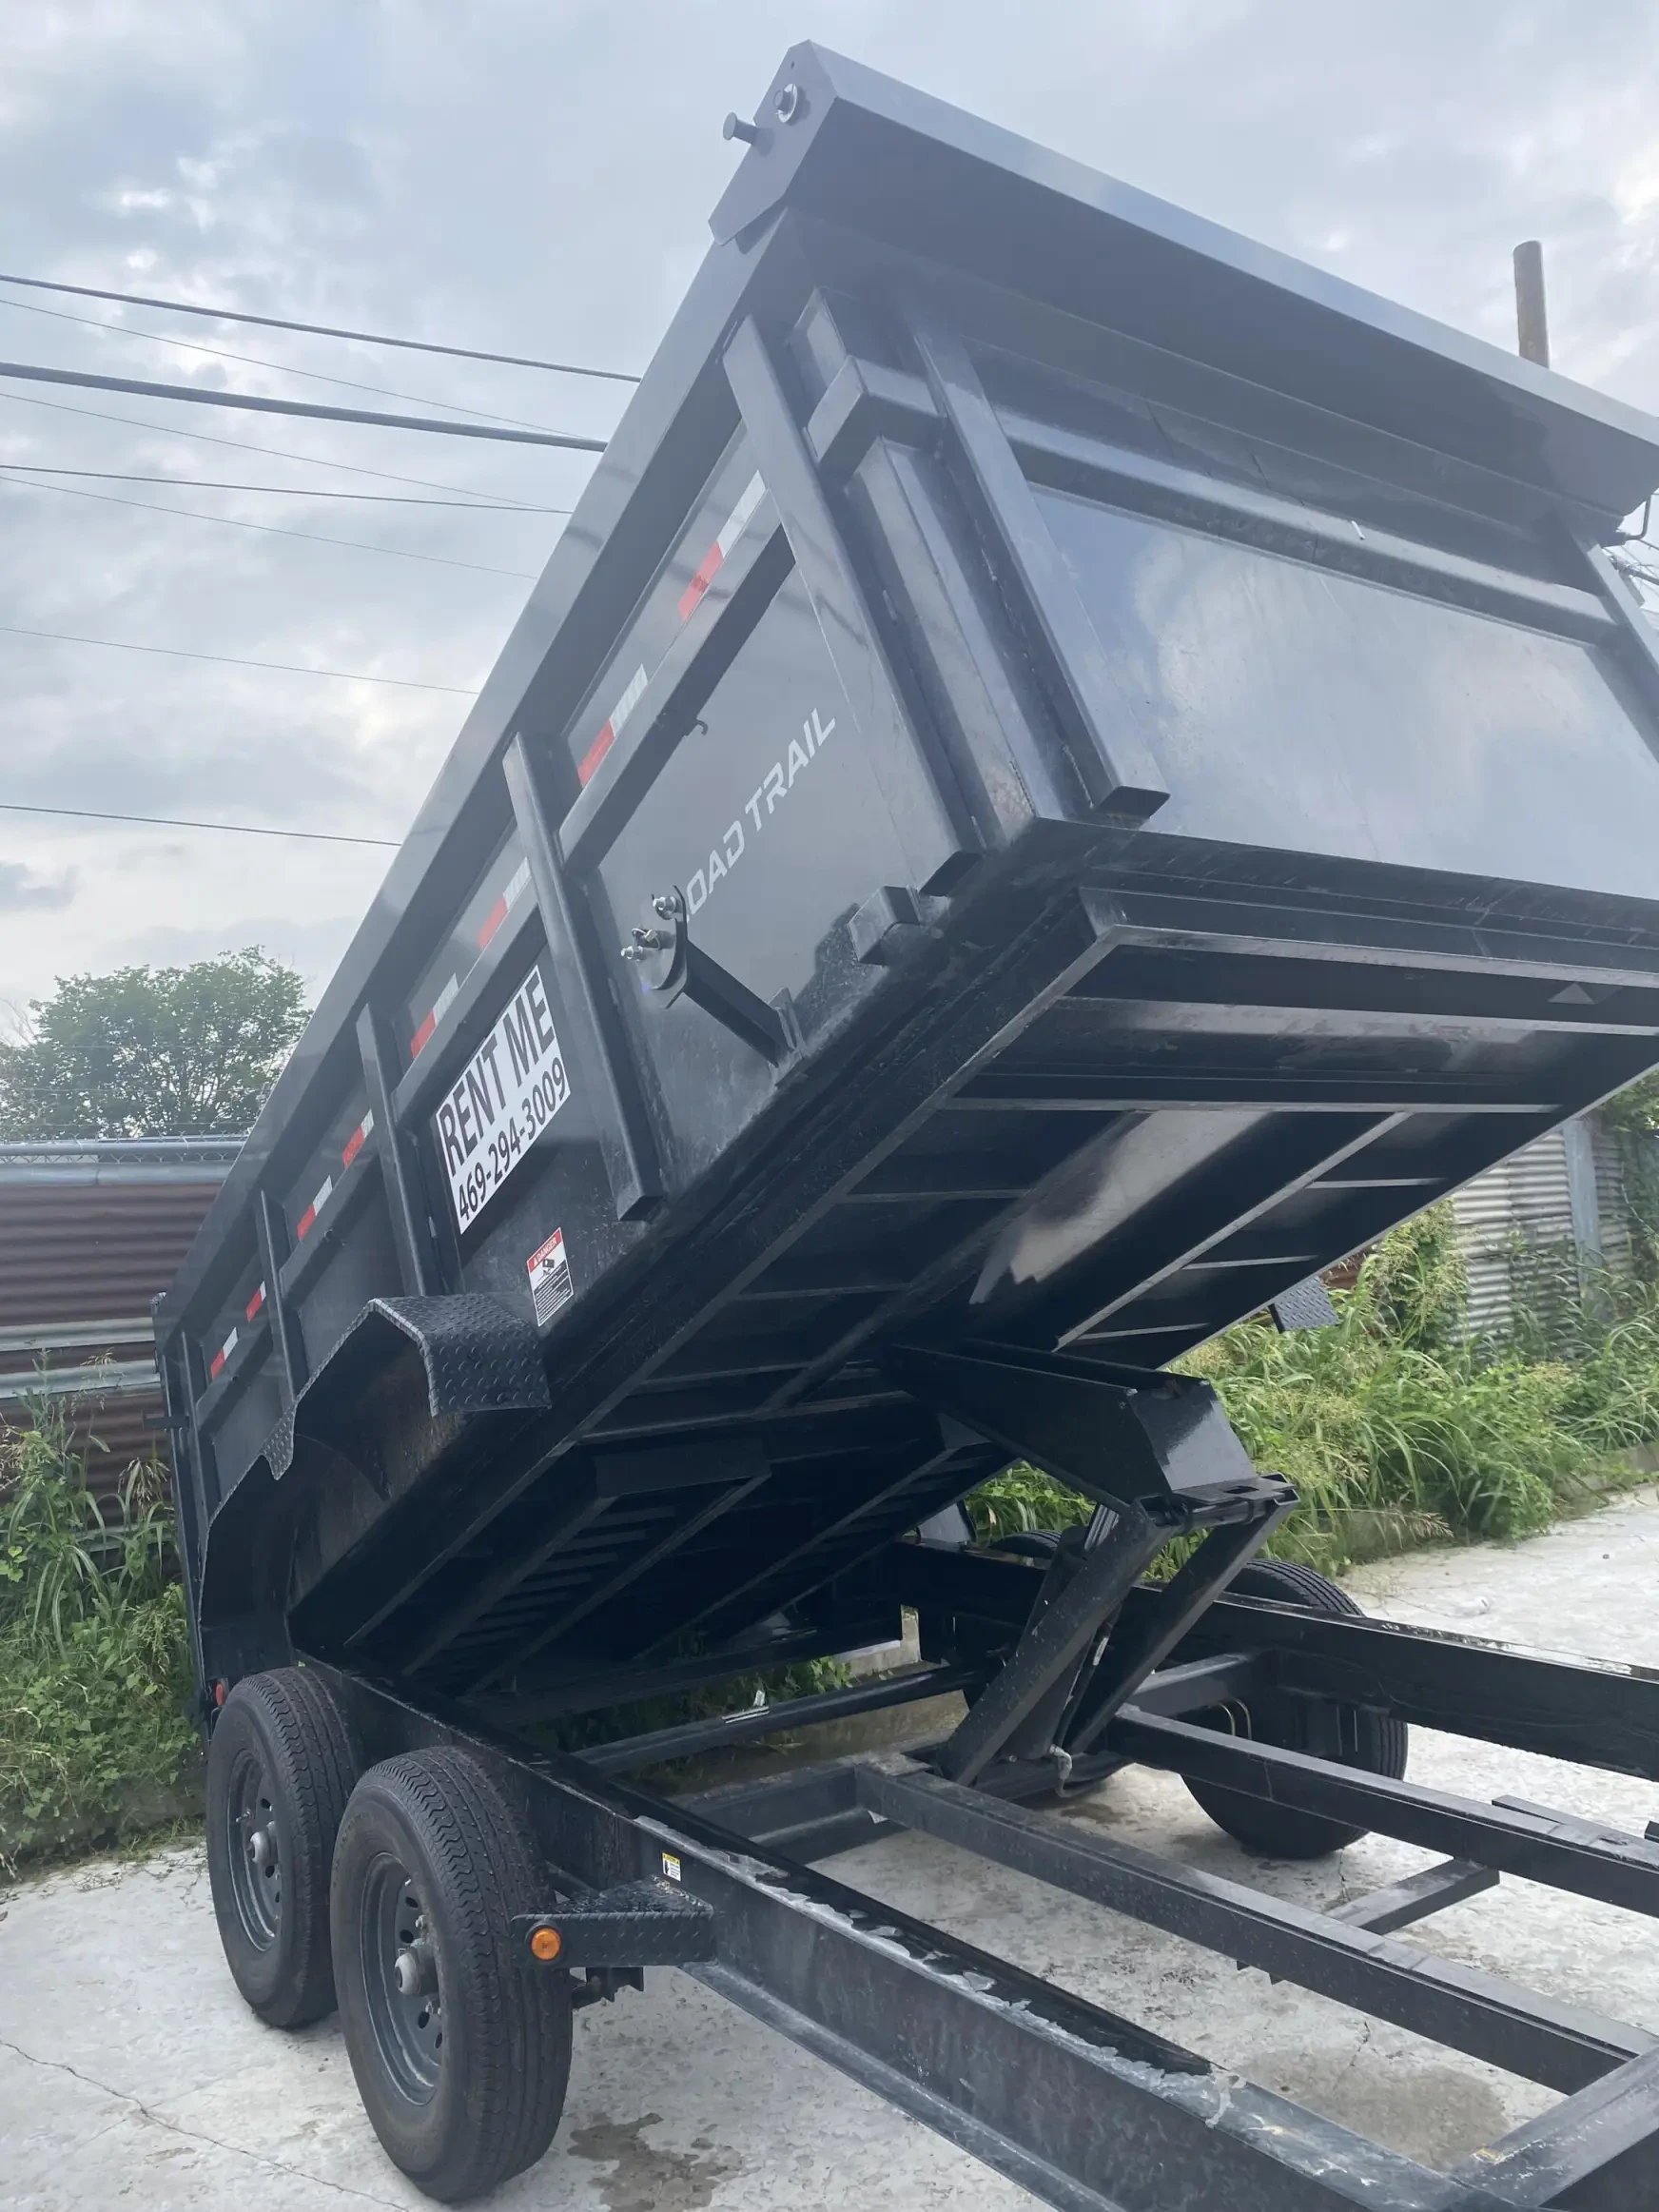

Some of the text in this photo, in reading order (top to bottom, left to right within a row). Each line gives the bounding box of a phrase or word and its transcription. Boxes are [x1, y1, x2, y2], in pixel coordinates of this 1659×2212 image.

[686, 707, 836, 923] OAD TRAIL
[439, 970, 556, 1178] RENT ME
[459, 1057, 566, 1222] 469-294-3009
[537, 1236, 557, 1260] DANGER
